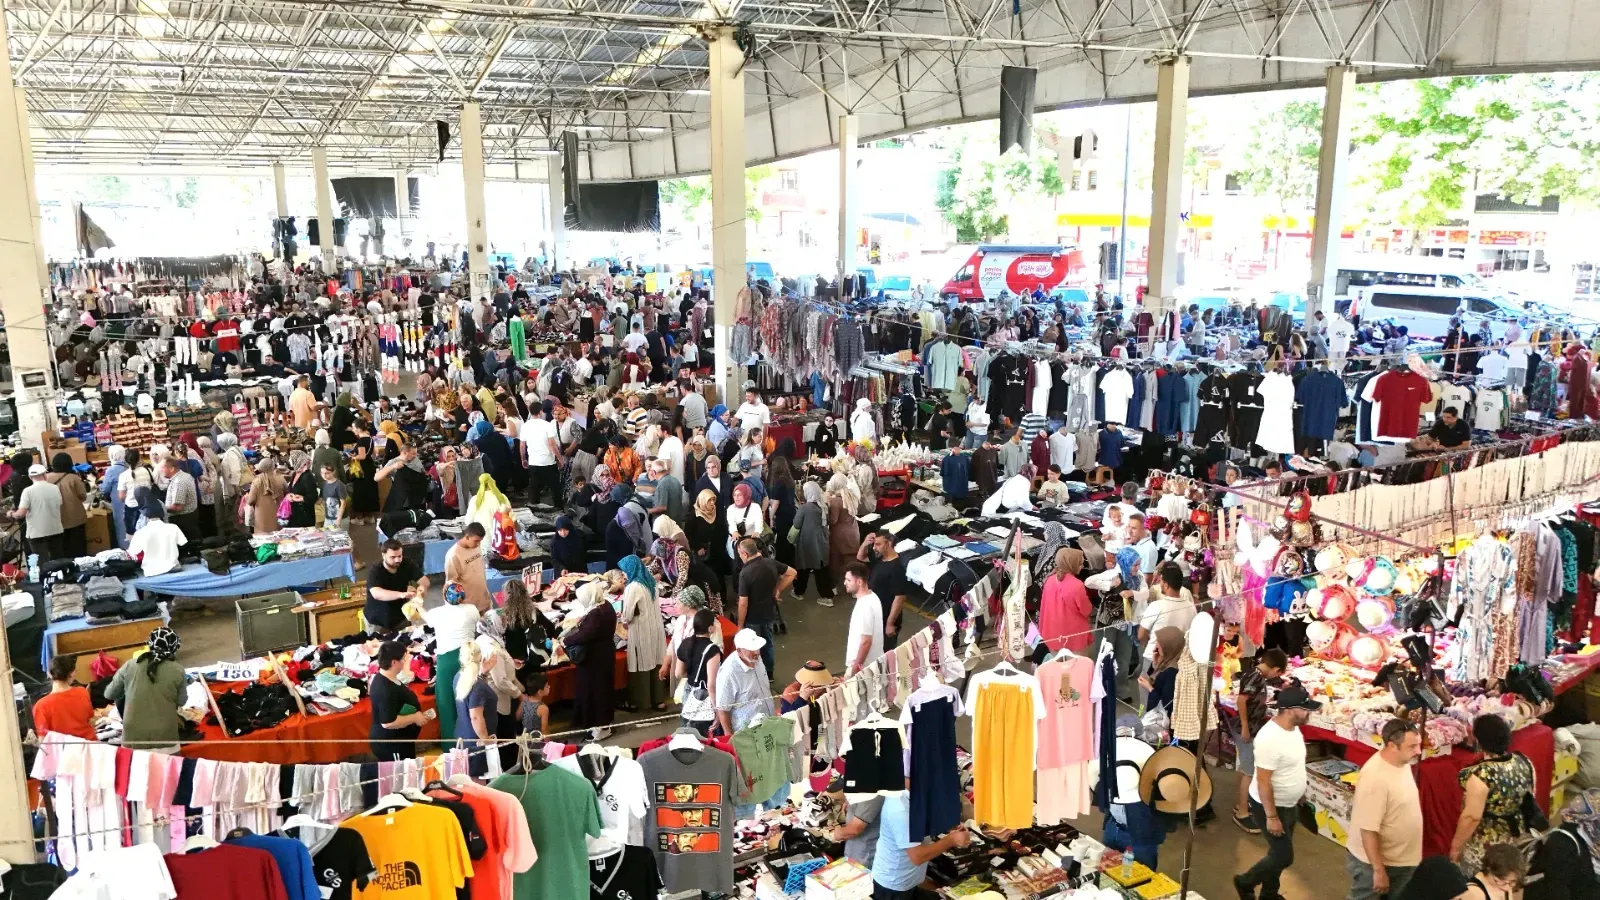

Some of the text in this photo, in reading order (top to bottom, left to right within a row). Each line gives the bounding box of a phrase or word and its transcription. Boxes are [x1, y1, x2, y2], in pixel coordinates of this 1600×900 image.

[383, 861, 404, 873] THE
[371, 870, 405, 885] NORTH
[381, 879, 406, 892] FACE
